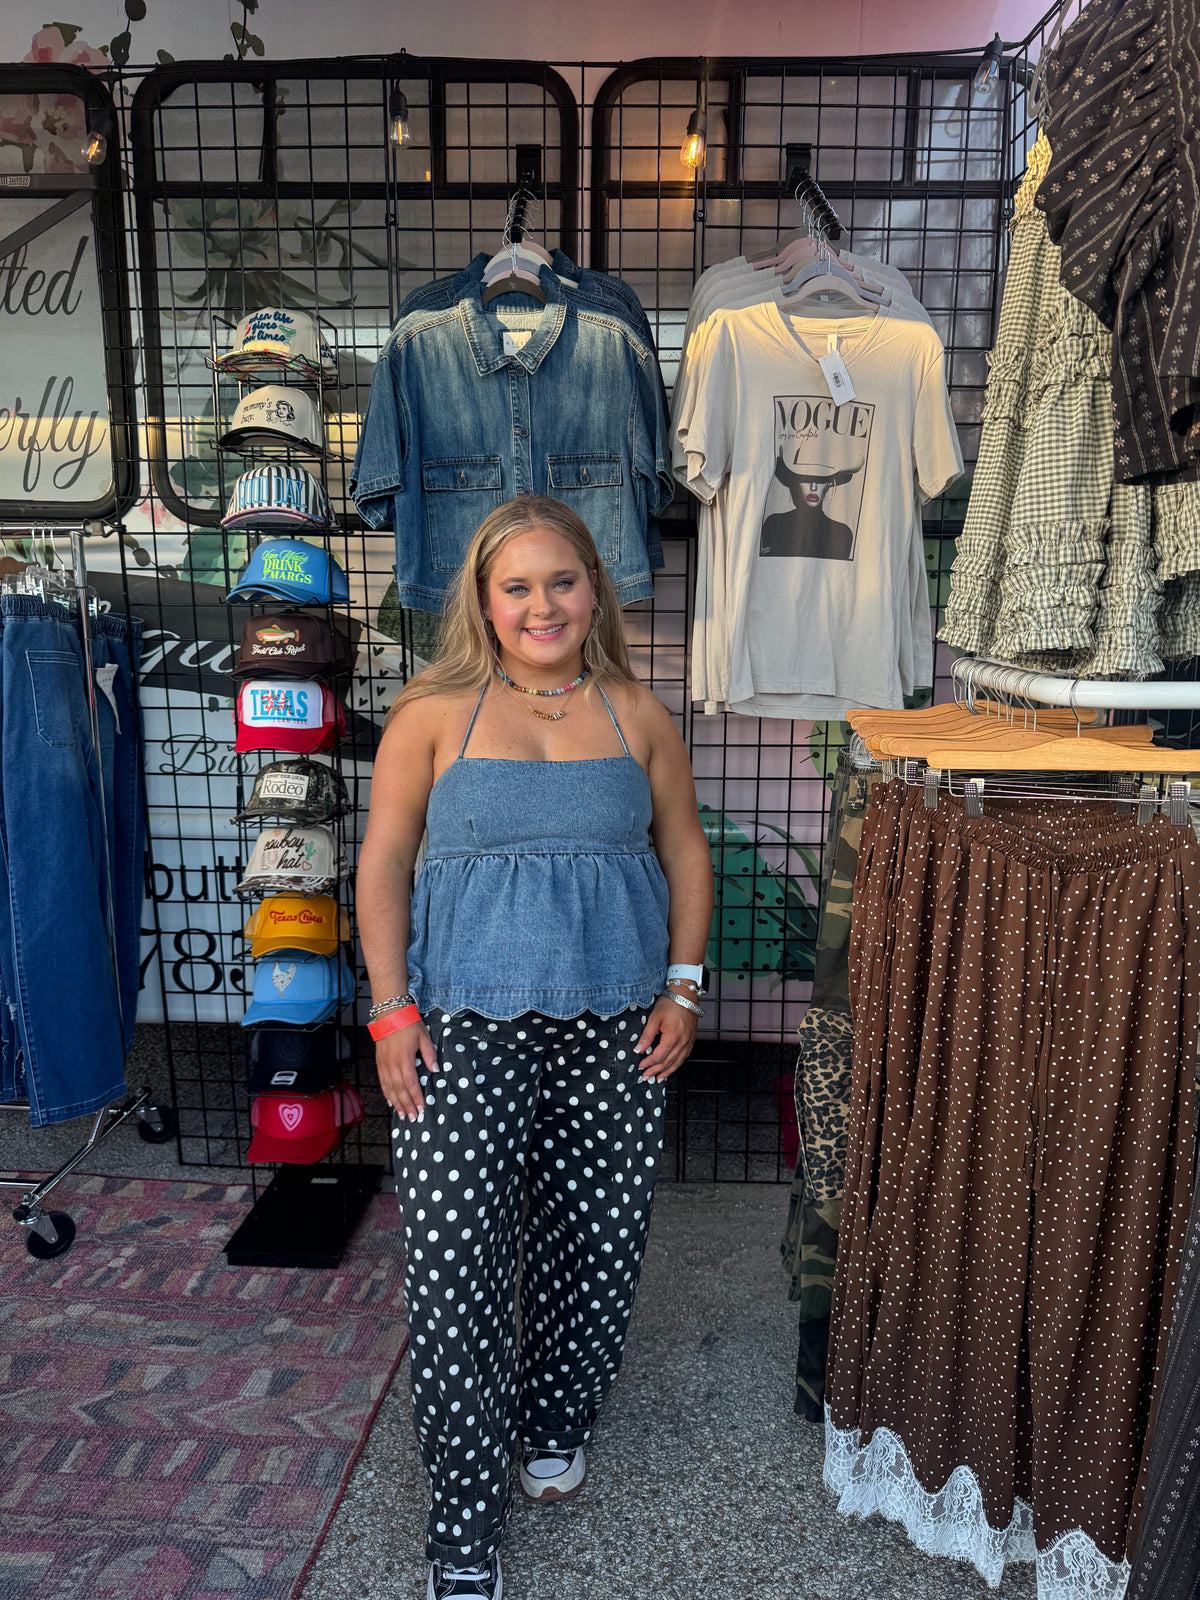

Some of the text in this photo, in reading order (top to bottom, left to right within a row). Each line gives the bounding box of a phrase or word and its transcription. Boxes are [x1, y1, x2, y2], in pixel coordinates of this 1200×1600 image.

[252, 322, 278, 335] gives
[257, 330, 287, 342] limes
[777, 400, 870, 438] VOGUE
[263, 559, 304, 573] DRINK
[270, 570, 312, 584] MARGS
[251, 690, 308, 718] TEXAS
[263, 779, 304, 796] Rodeo
[264, 829, 304, 852] cowboy
[276, 850, 305, 869] hat
[269, 909, 324, 925] Texas Chica
